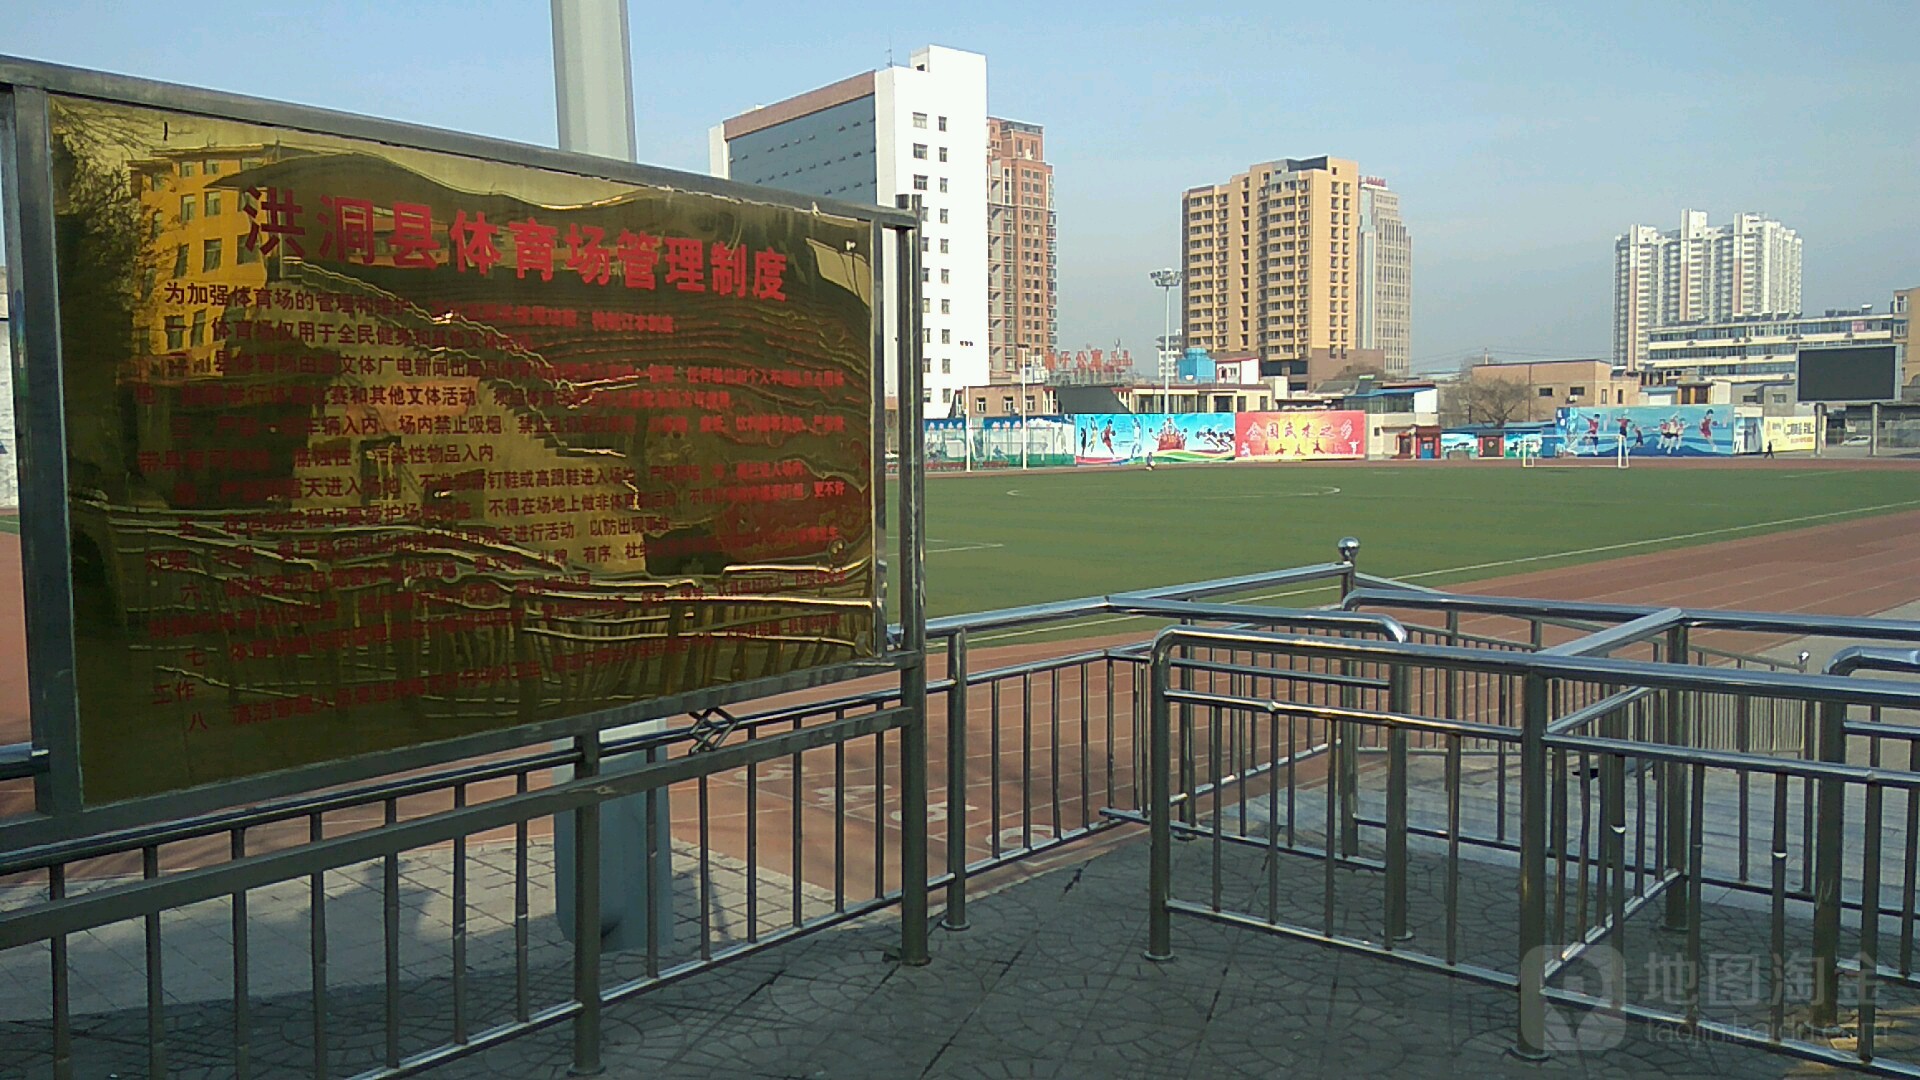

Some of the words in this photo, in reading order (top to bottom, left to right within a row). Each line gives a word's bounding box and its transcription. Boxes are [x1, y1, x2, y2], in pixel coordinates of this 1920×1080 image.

[241, 186, 788, 301] 洪洞县体育场管理制度
[1246, 419, 1354, 441] 全国武术之乡
